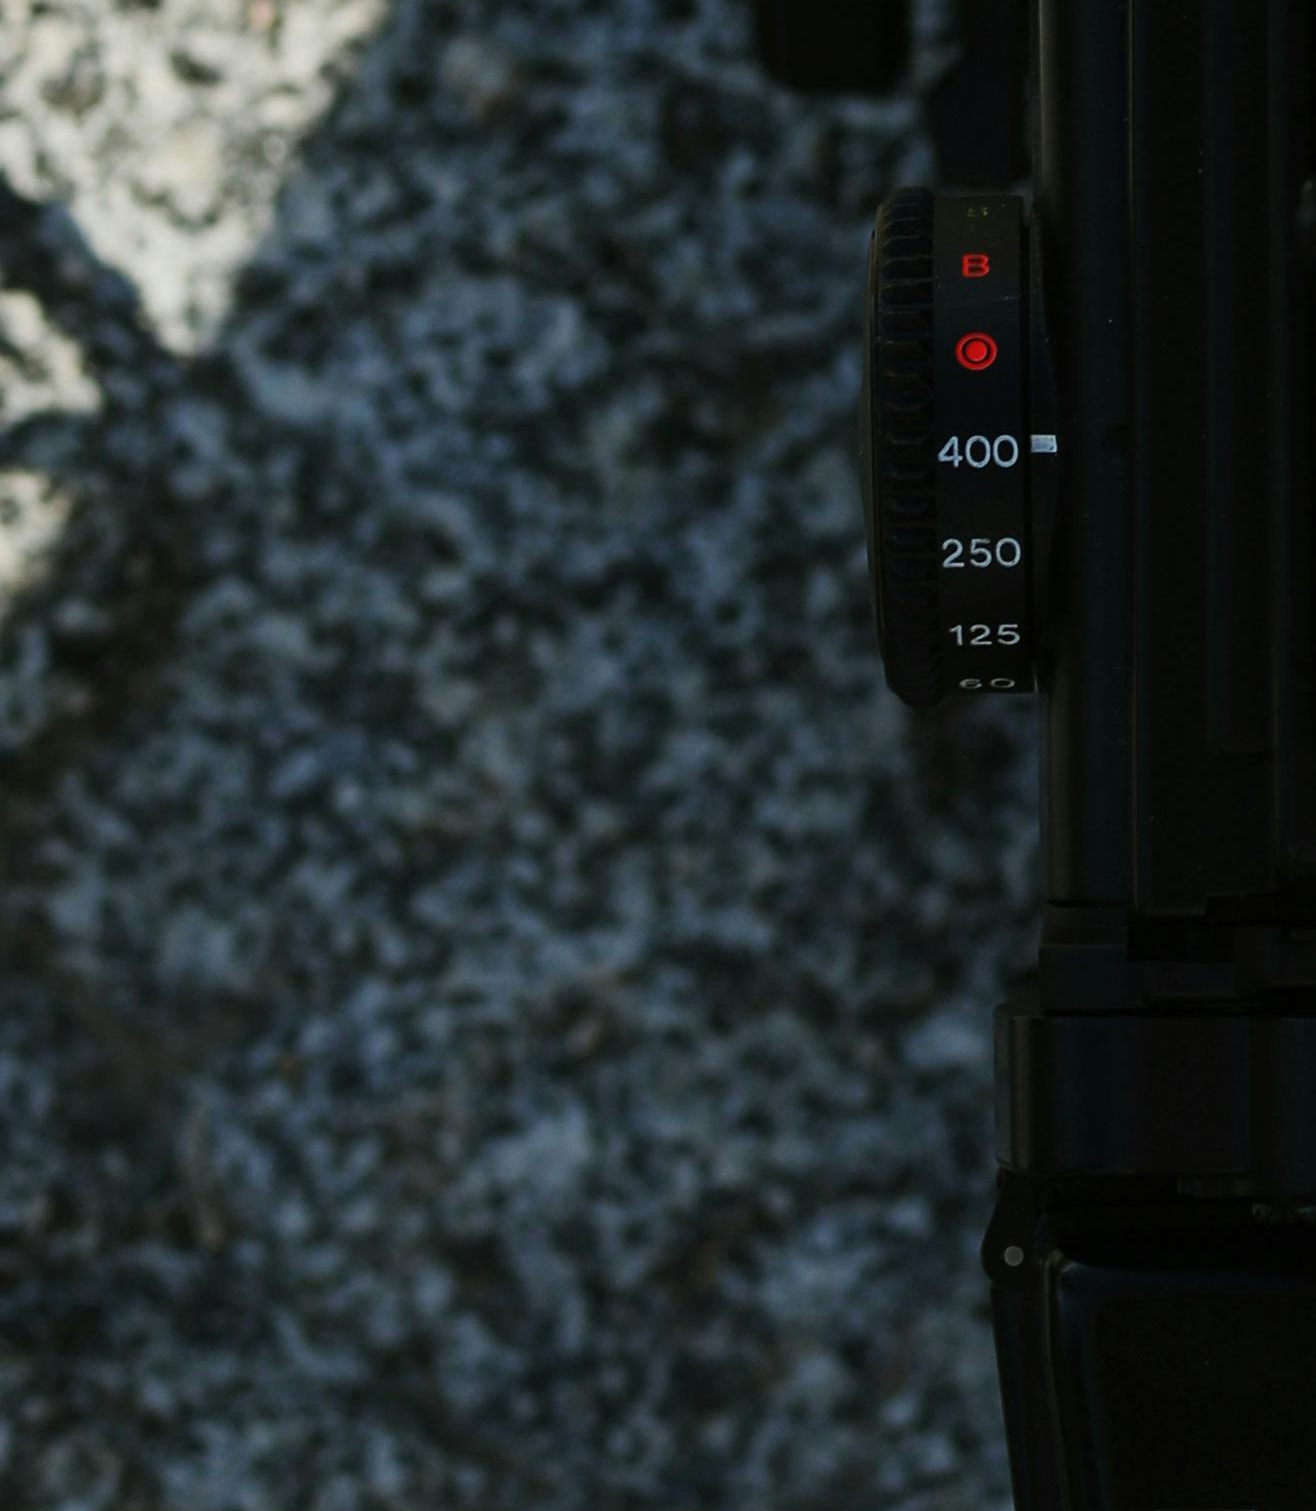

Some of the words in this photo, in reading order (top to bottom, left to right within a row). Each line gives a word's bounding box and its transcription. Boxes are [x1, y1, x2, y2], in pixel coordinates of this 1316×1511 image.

[961, 254, 990, 278] B
[938, 434, 1019, 469] 400
[942, 537, 1022, 568] 250
[949, 623, 1021, 646] 125
[959, 677, 1016, 689] 60
